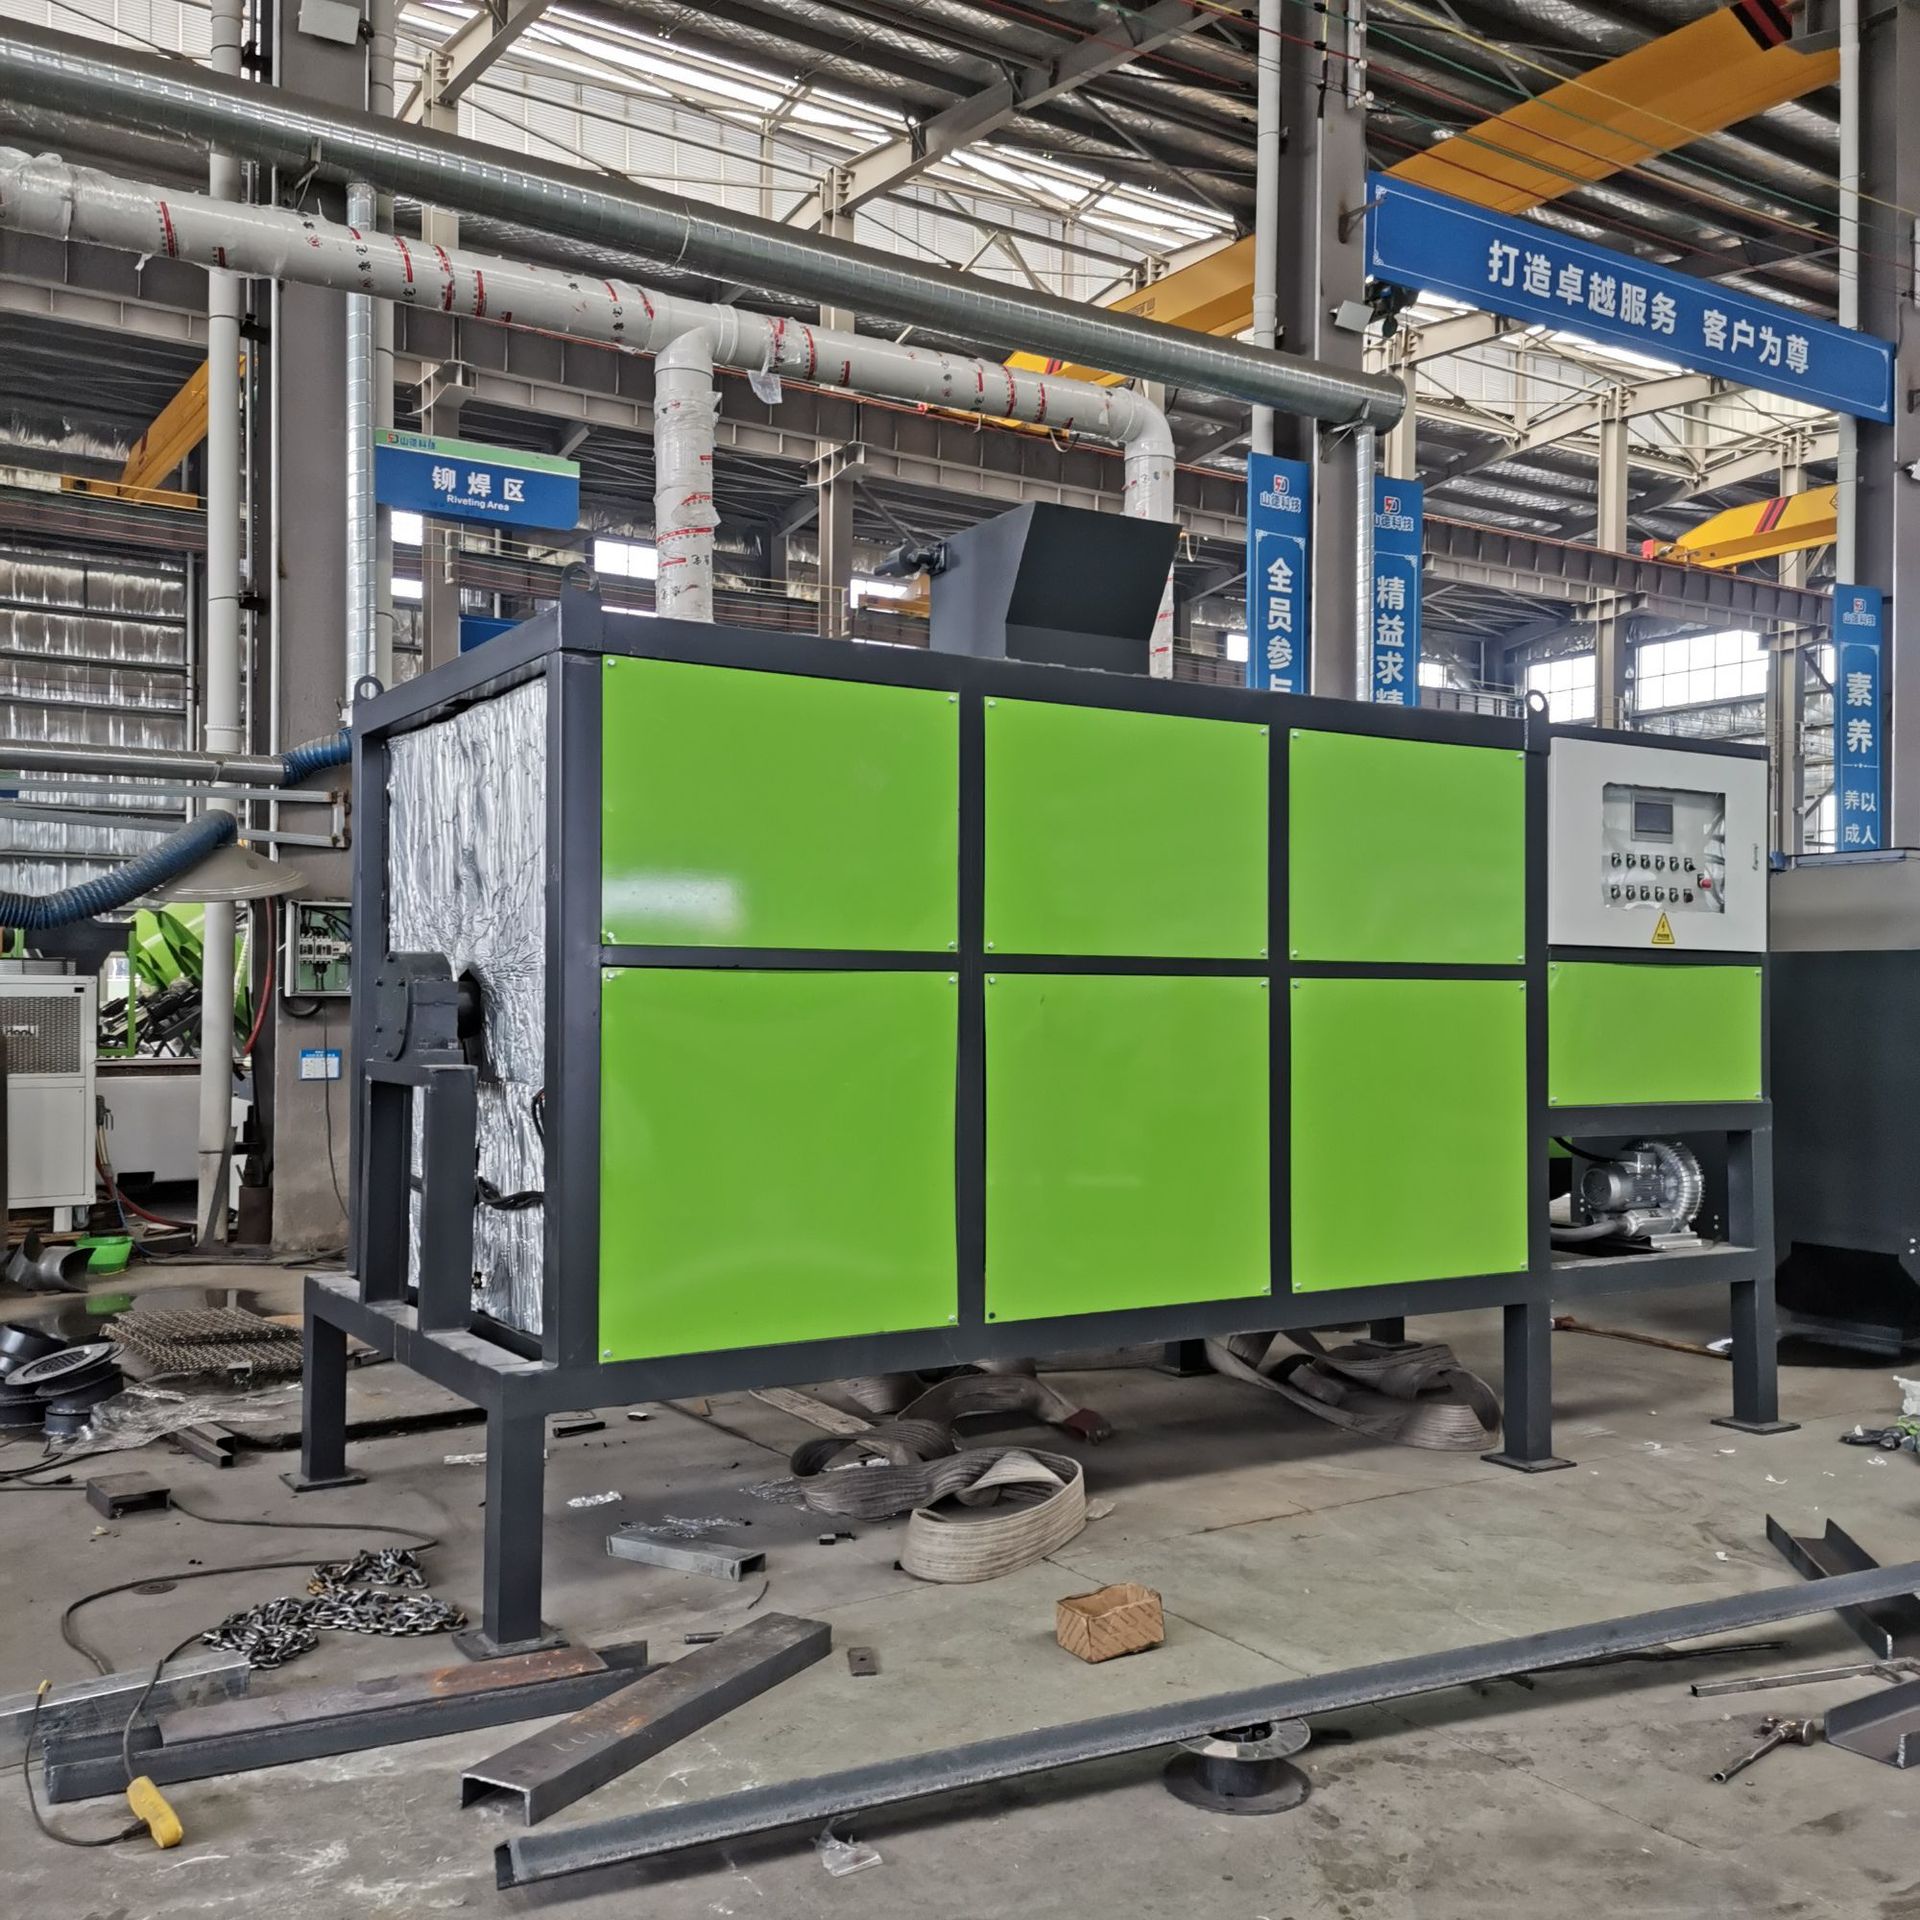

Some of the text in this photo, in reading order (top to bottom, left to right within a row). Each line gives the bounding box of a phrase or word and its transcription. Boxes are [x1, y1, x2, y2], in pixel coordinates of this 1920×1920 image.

[1488, 239, 1809, 375] 打造卓越服务 客户为尊
[446, 494, 510, 512] Riveting Area
[1846, 672, 1873, 753] 素养
